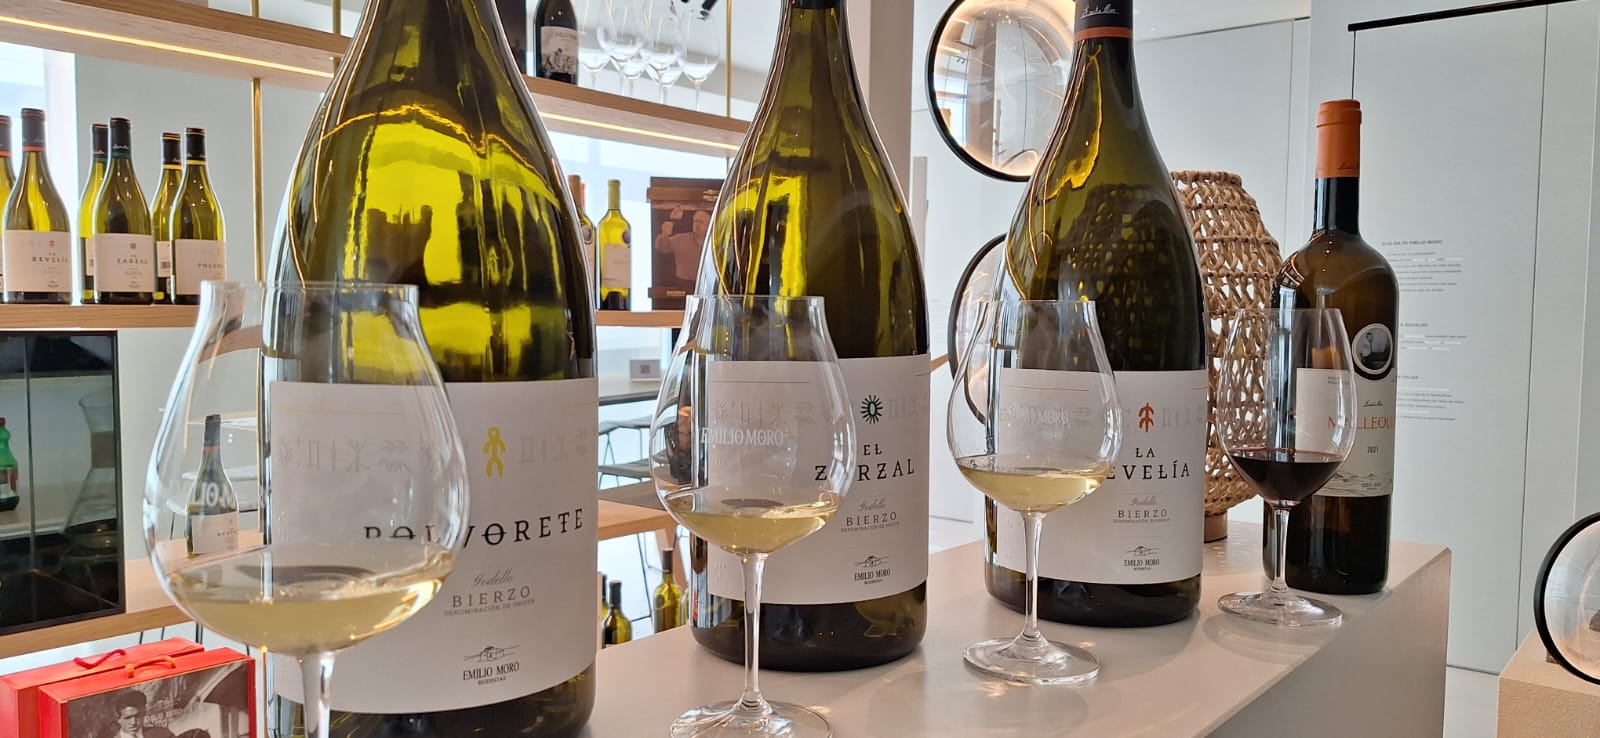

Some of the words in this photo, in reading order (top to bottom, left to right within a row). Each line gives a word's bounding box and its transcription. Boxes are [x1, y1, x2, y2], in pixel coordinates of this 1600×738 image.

[701, 427, 744, 445] EMILIO
[745, 428, 785, 447] MORO
[863, 443, 882, 456] EL
[1135, 447, 1156, 459] LA
[815, 458, 915, 482] ZRZAL
[1106, 459, 1190, 480] EVELÍA
[846, 511, 897, 527] BIERZO
[1118, 508, 1167, 519] BIERZO
[854, 571, 874, 582] EMILIO
[875, 568, 891, 578] MORO
[452, 586, 530, 608] BIERZO
[463, 667, 493, 681] EMILIO
[496, 661, 520, 675] MORO
